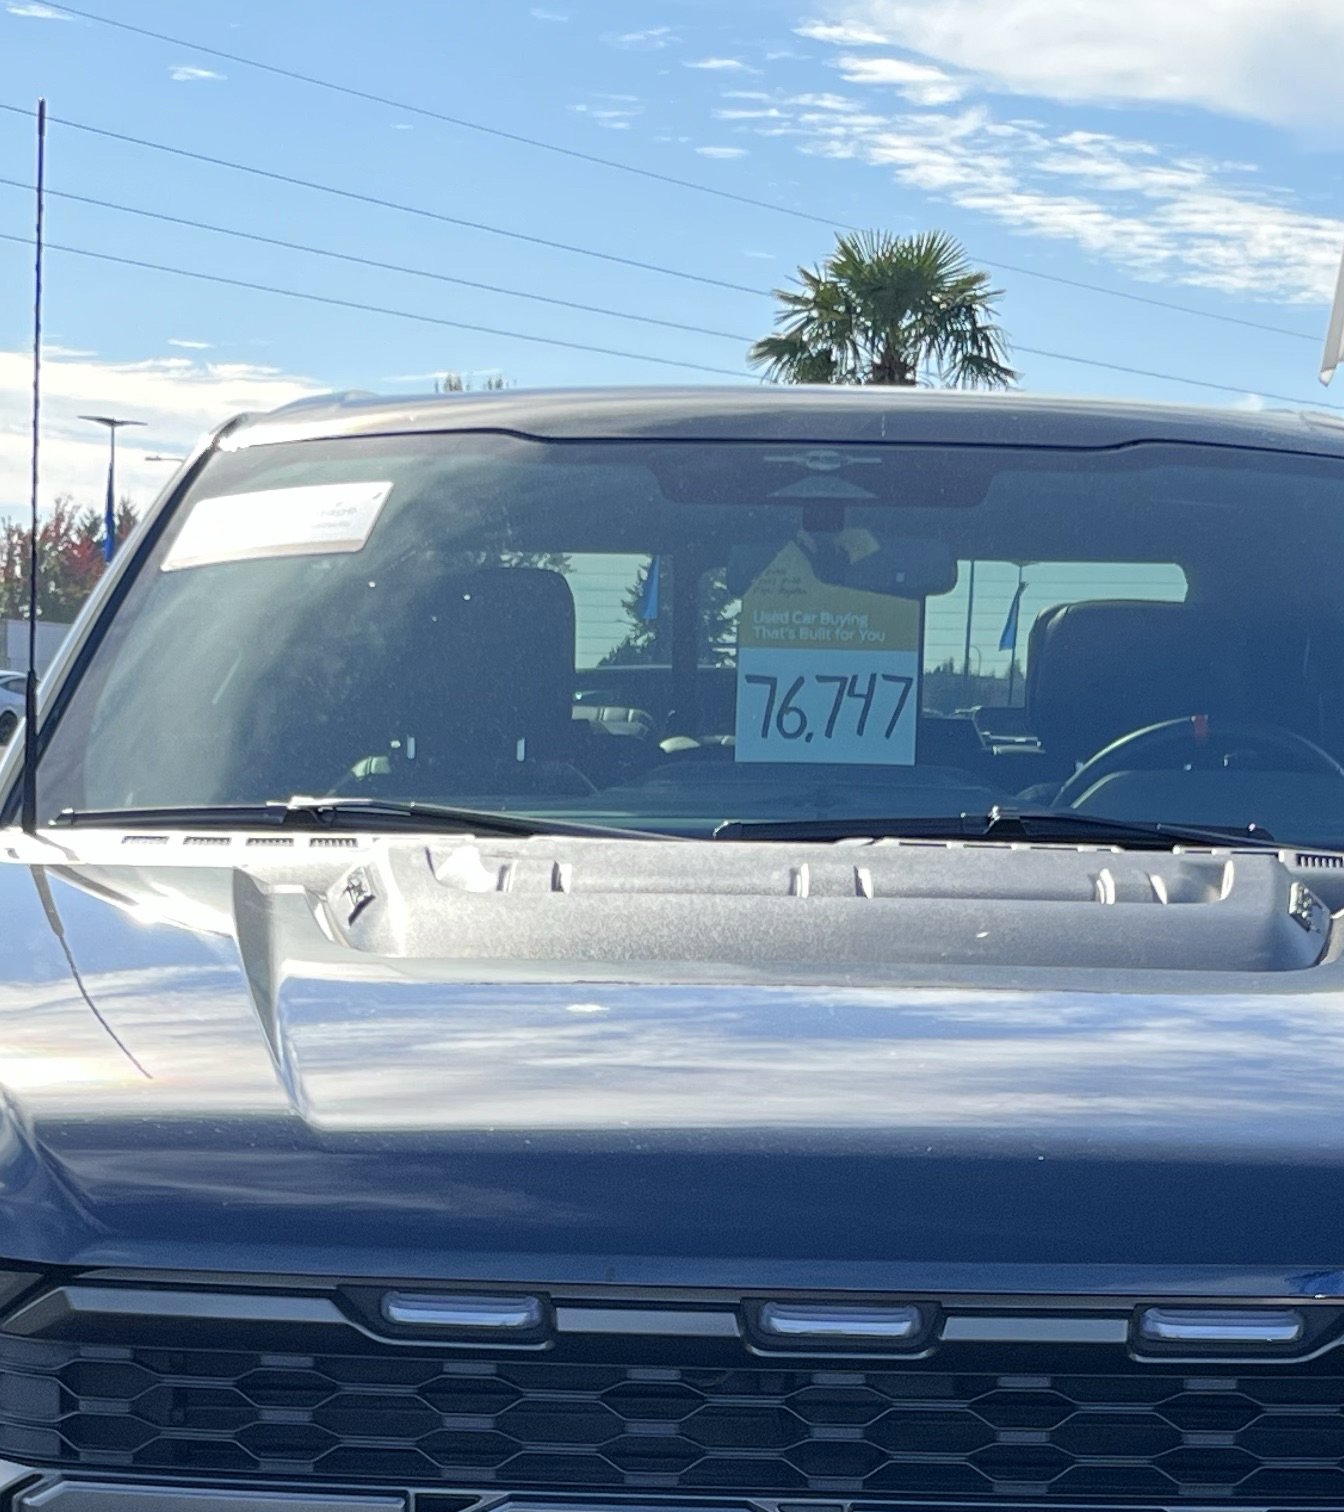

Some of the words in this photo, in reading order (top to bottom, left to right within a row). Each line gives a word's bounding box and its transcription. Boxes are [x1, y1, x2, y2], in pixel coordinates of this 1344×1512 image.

[752, 610, 789, 624] Used
[792, 611, 816, 625] Car
[820, 611, 869, 628] Buying
[752, 625, 796, 640] That's
[799, 627, 832, 641] Built
[835, 627, 855, 641] for
[858, 629, 886, 642] You
